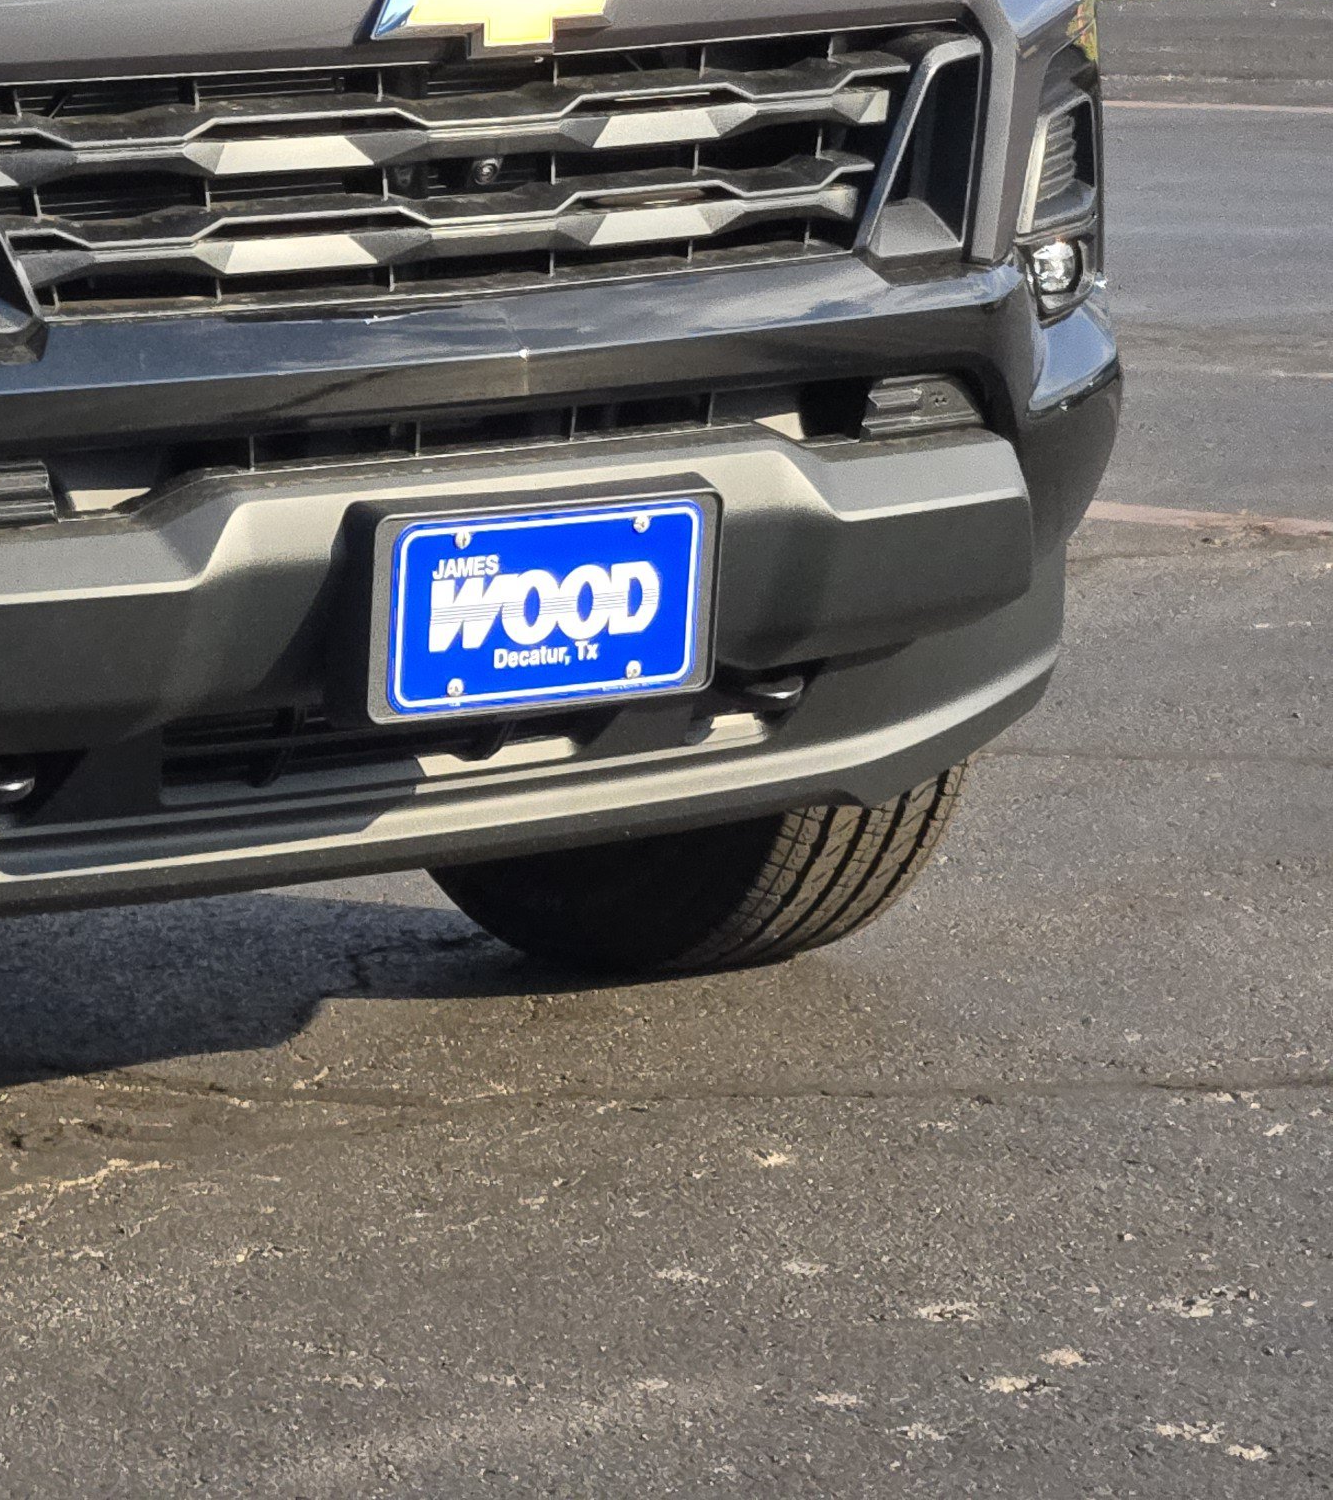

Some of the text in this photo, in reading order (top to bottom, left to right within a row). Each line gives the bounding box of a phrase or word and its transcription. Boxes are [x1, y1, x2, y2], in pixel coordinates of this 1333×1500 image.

[432, 554, 500, 580] JAMES
[428, 560, 661, 653] WOOD
[493, 640, 599, 669] Decatur, Tx
